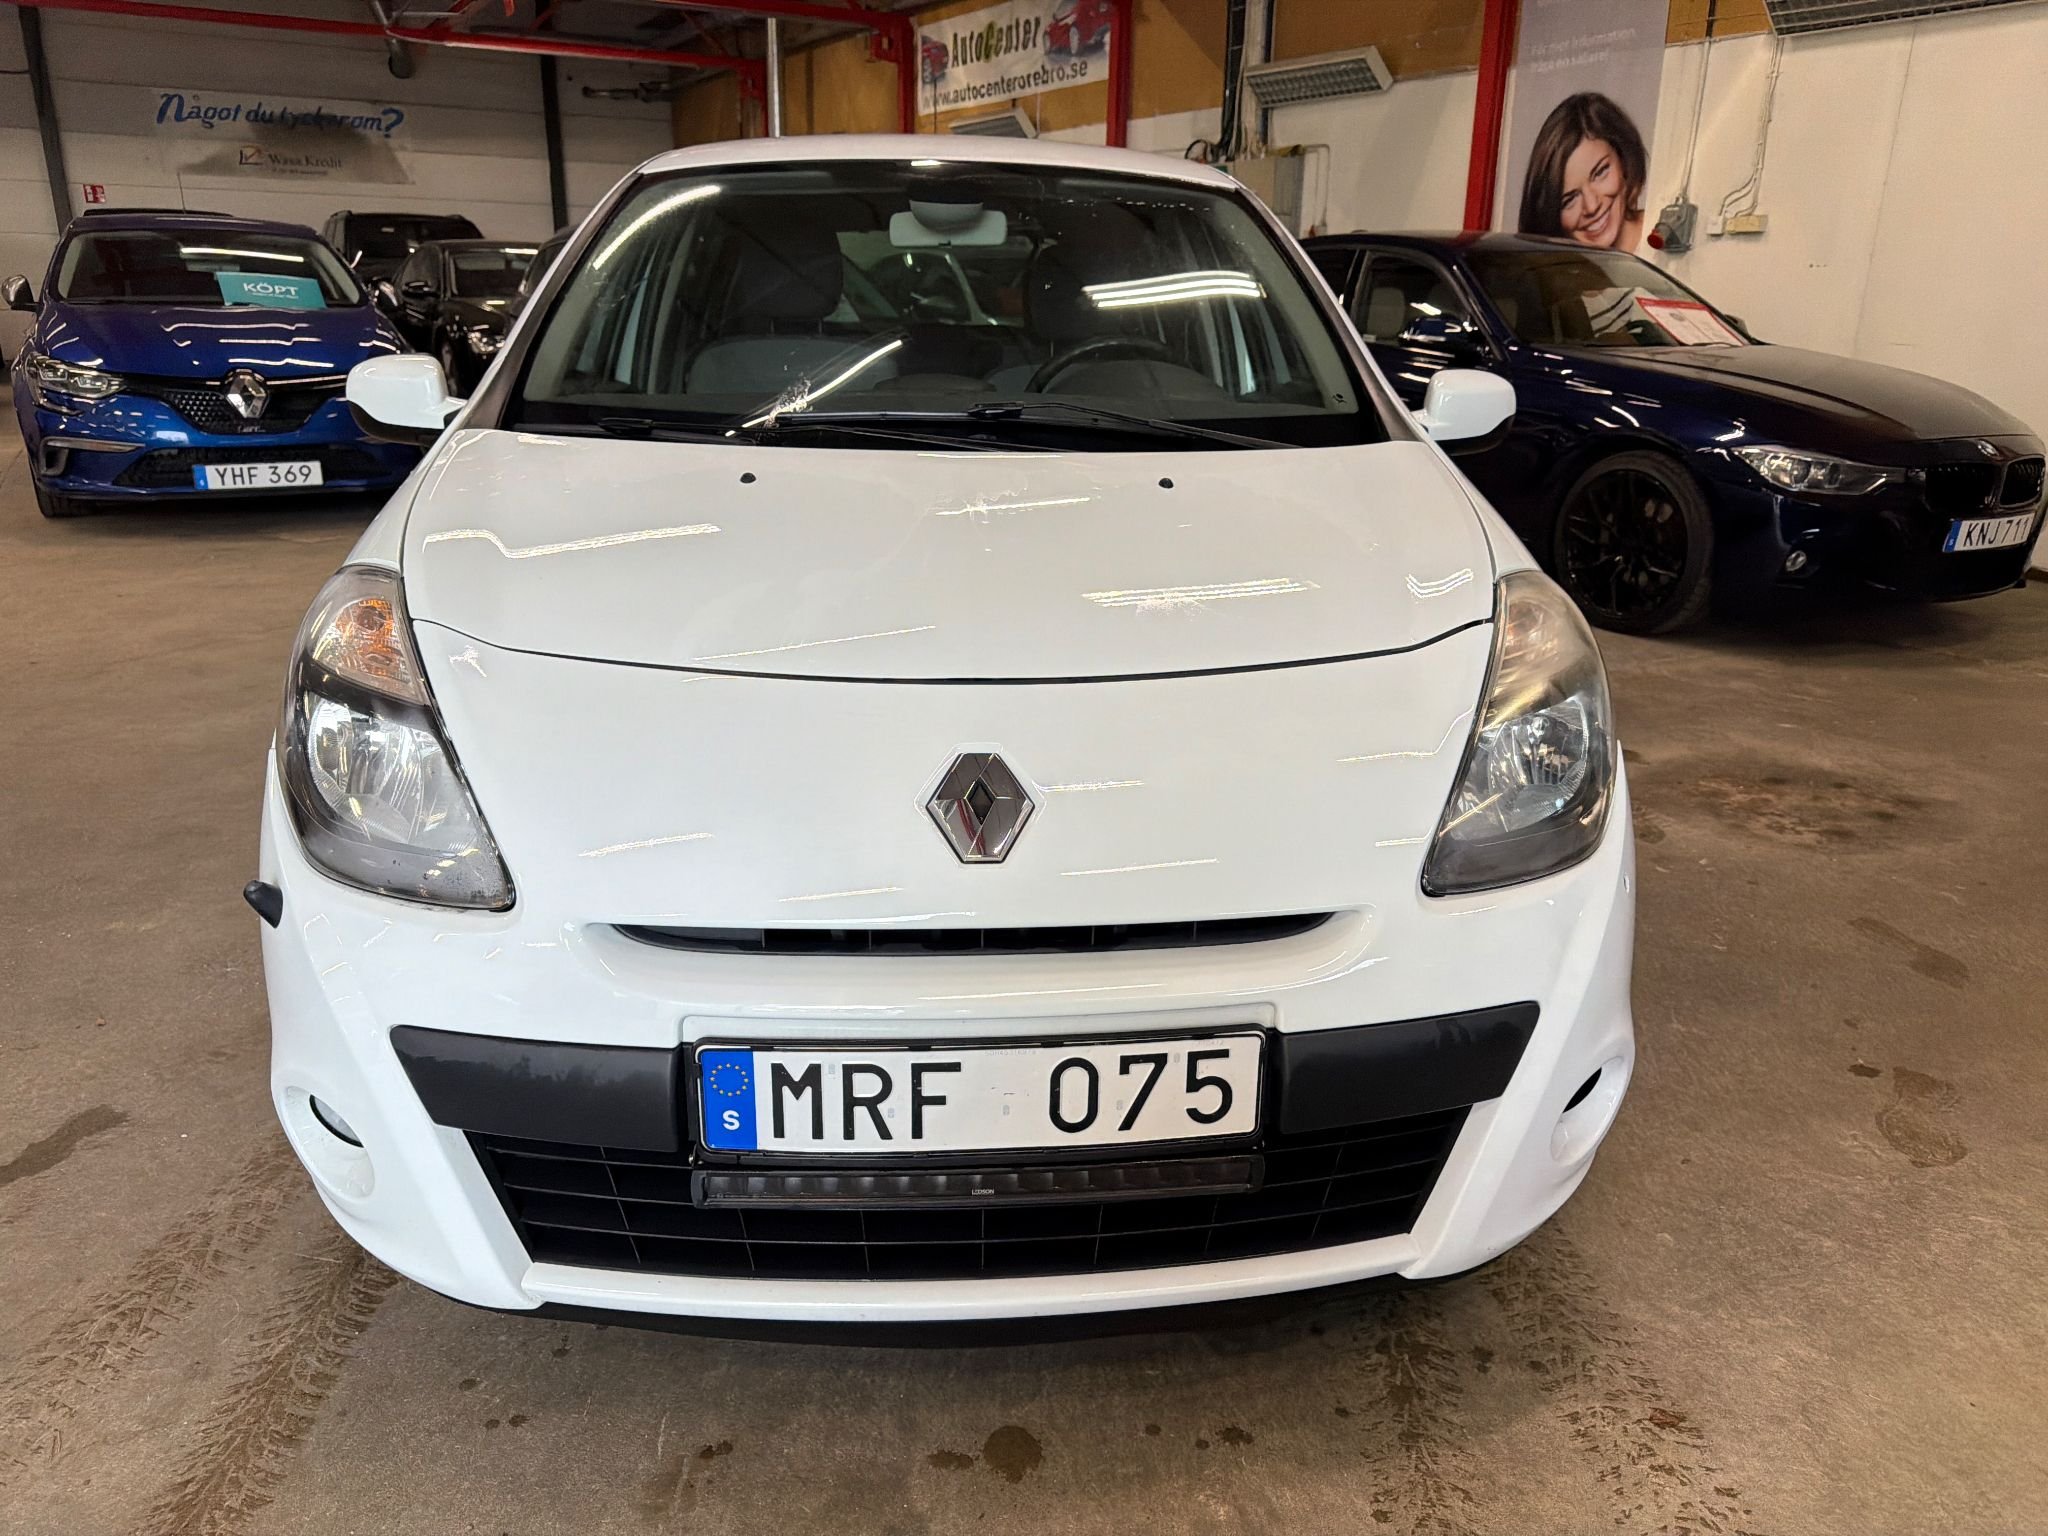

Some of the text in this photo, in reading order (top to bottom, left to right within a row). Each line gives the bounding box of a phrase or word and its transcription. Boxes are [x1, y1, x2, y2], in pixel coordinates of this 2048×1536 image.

[951, 16, 1041, 68] AutoCenter
[923, 60, 1088, 110] www.autocenterorebro.se
[156, 92, 242, 130] Något
[245, 101, 275, 125] du
[243, 282, 298, 296] KÖPT
[215, 464, 312, 486] YHF 369
[1963, 517, 2030, 547] KNJ 711
[771, 1048, 1233, 1141] MRF 075
[722, 1109, 741, 1131] S
